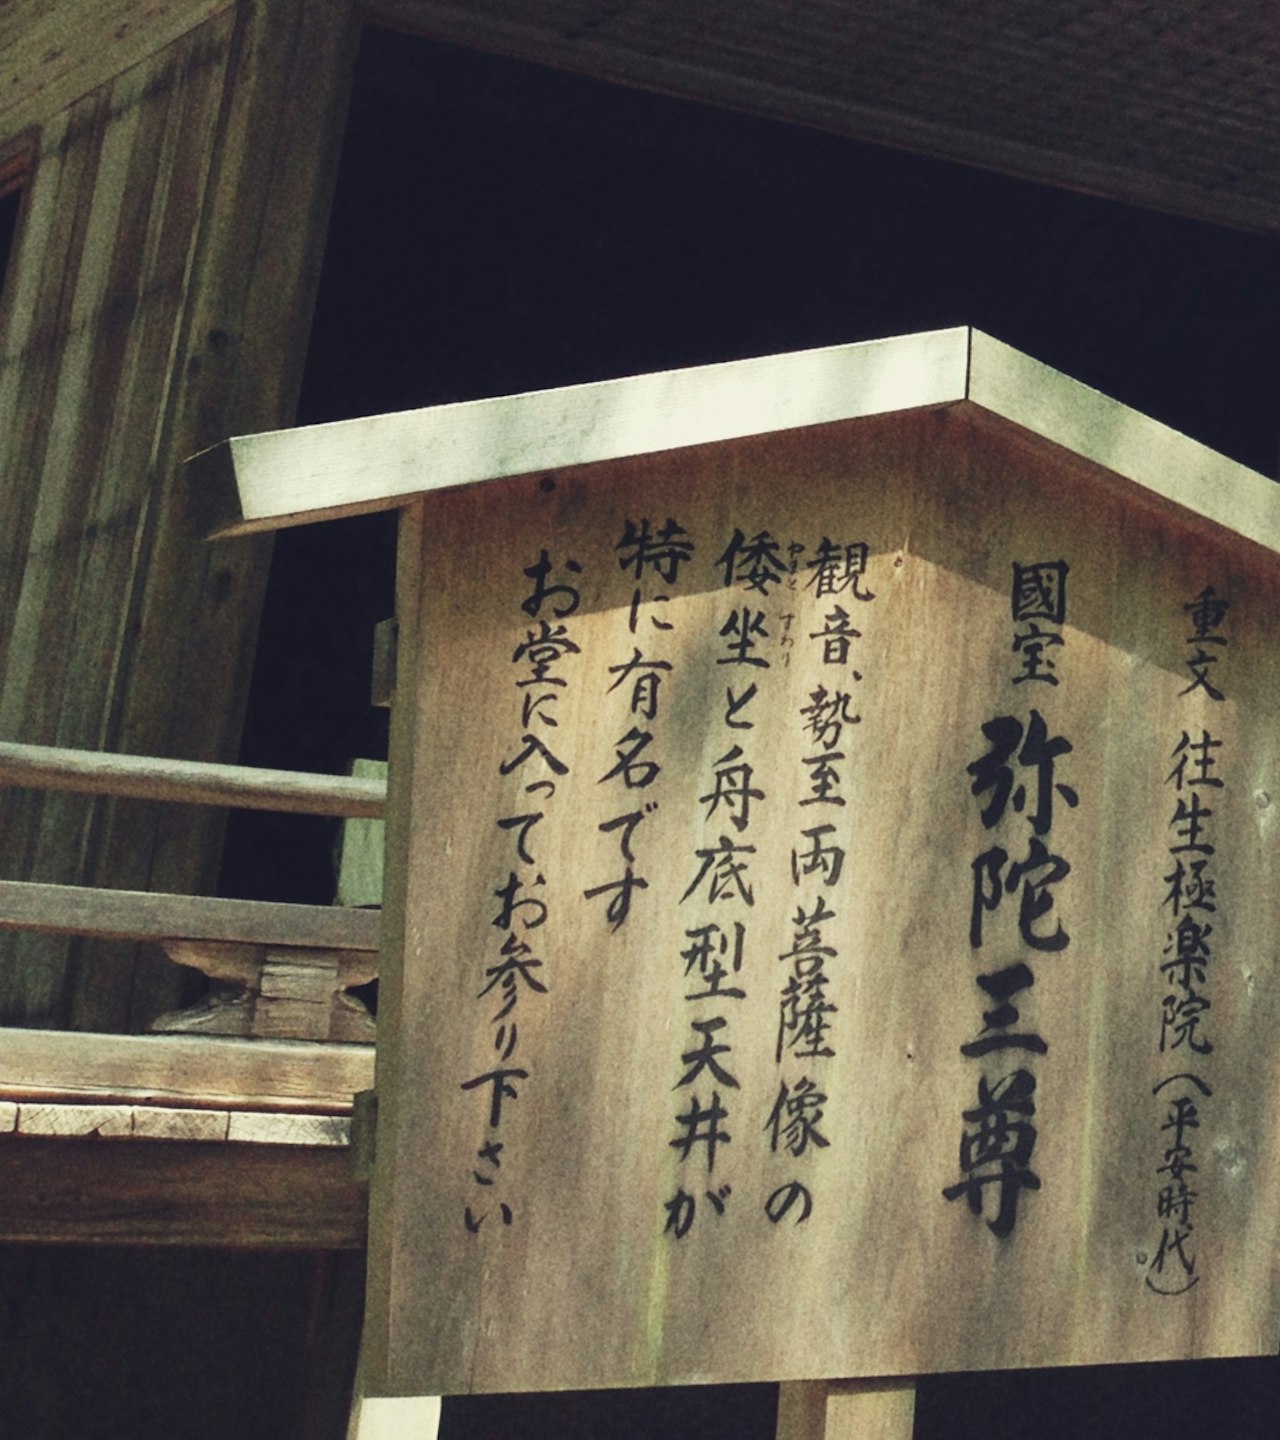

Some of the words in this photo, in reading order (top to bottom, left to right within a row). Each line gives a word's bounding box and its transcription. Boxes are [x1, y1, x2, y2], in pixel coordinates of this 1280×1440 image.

[461, 549, 582, 1235] お堂に入ってお参り下さい
[584, 517, 696, 931] 特に有名です
[664, 528, 788, 1240] 倭坐と舟底型天井が
[1177, 586, 1232, 703] 重文
[941, 710, 1080, 1237] 弥陀三尊
